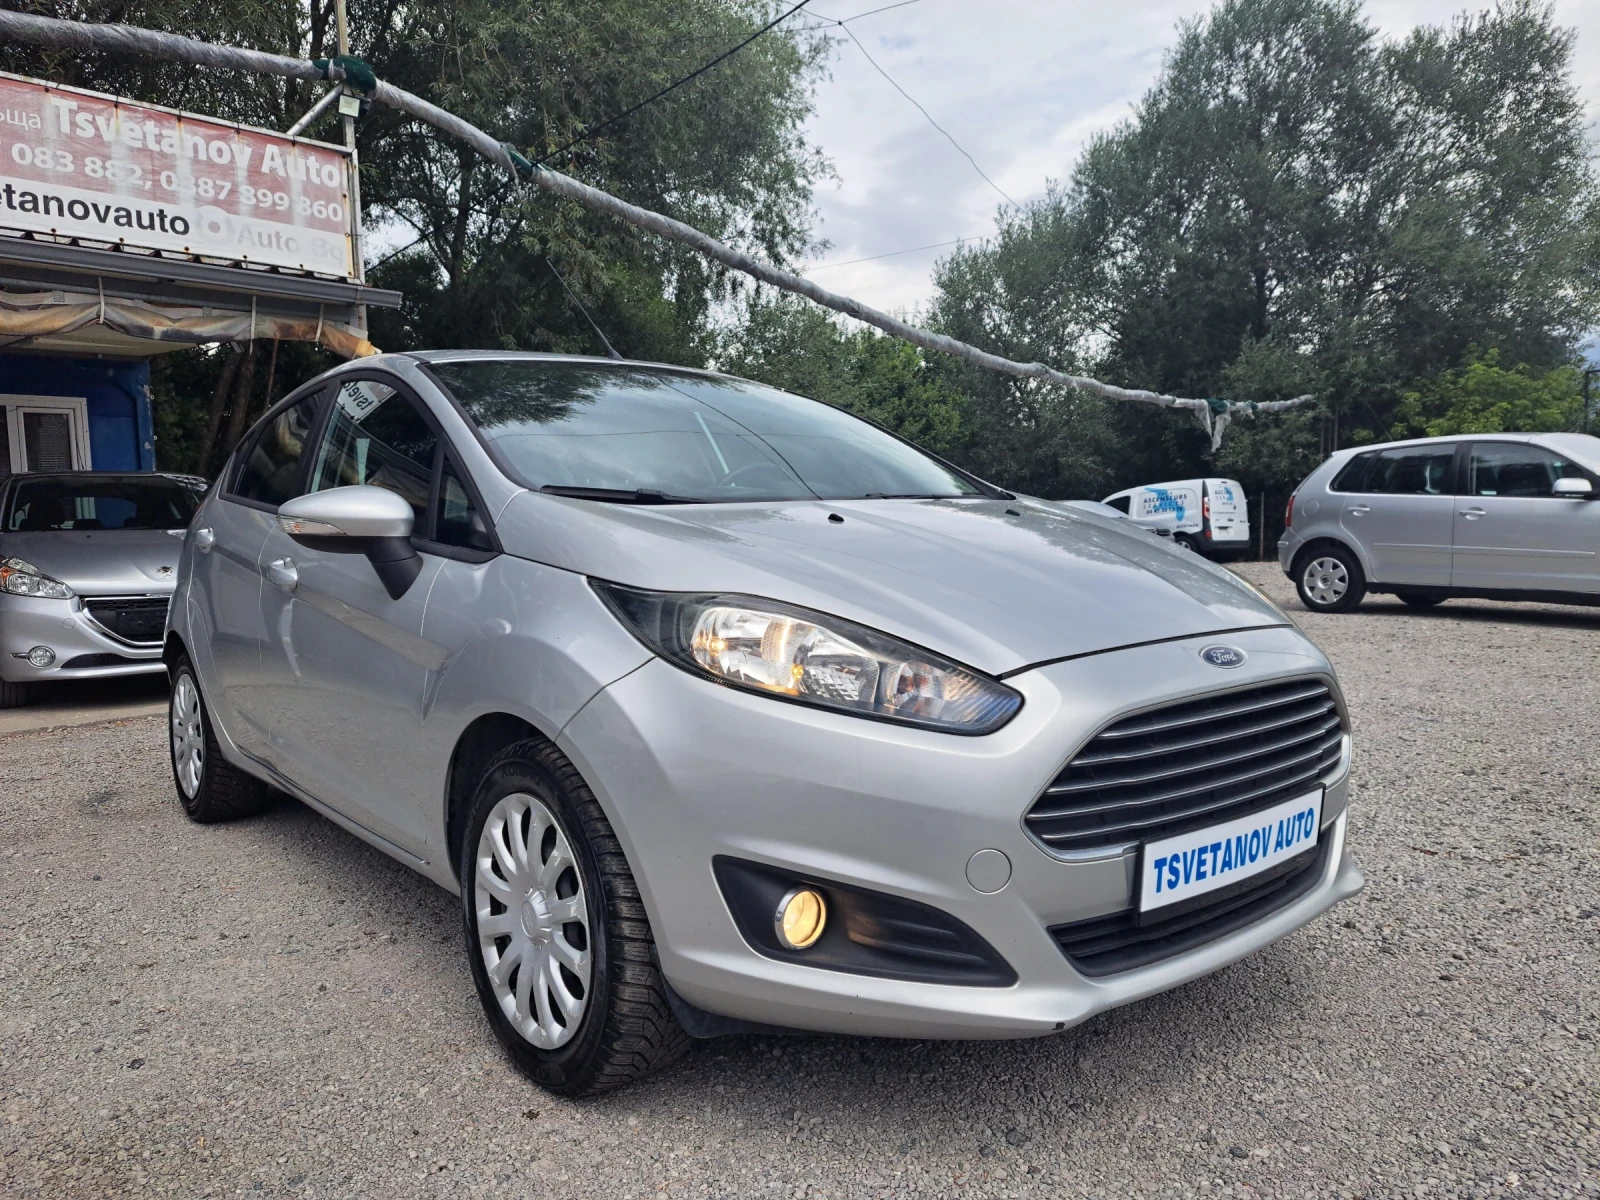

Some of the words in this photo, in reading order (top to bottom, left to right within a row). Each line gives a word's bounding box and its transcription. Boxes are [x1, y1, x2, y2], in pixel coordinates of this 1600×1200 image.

[51, 99, 252, 166] Tsvetanov
[261, 144, 341, 188] Auto
[12, 143, 74, 173] 083
[84, 157, 152, 190] 882,
[239, 185, 290, 211] 899
[0, 183, 190, 236] tanovauto
[237, 225, 300, 253] Auto
[1143, 493, 1188, 504] ASCENSEURS
[1210, 649, 1238, 664] Ford
[1154, 824, 1273, 894] TSVETANOV
[1274, 807, 1315, 853] AUTO
